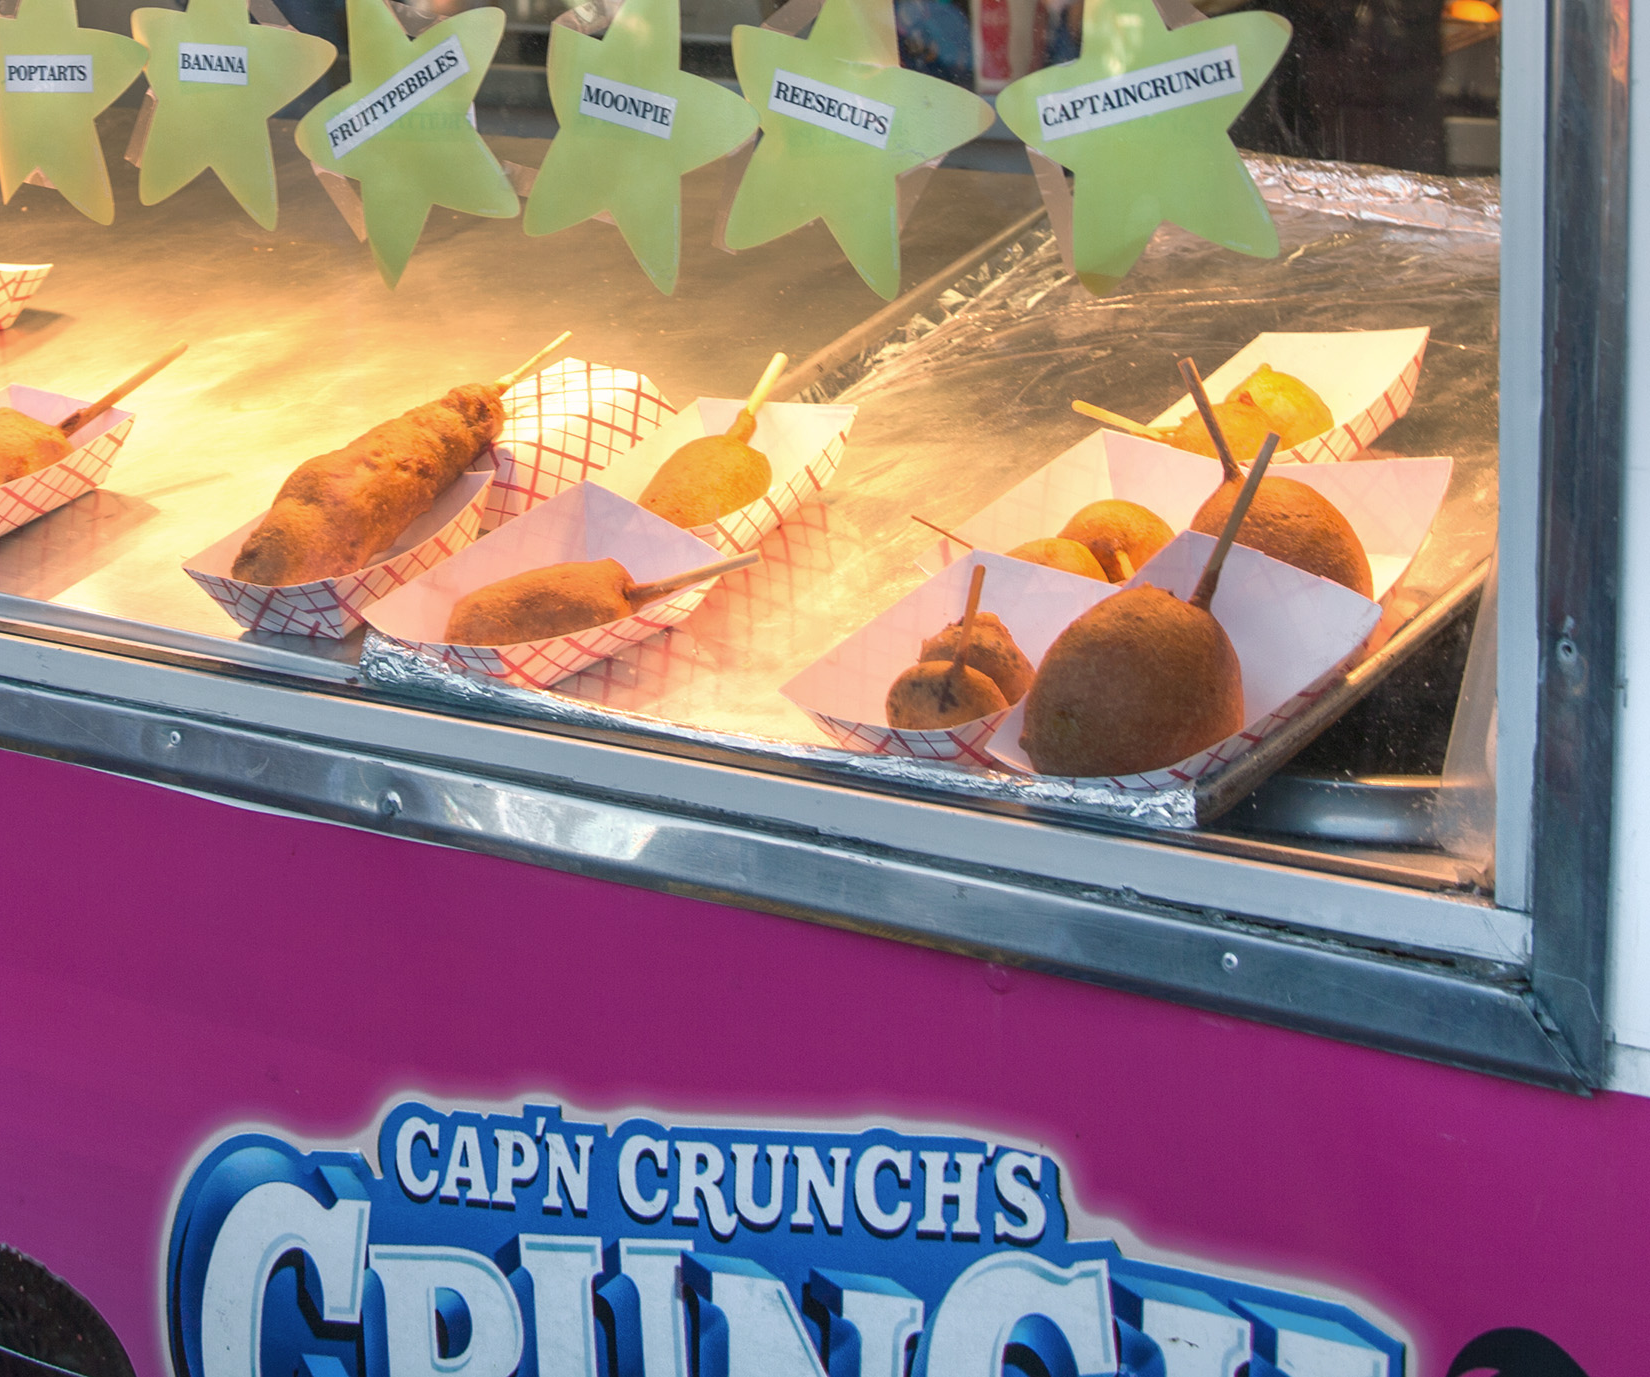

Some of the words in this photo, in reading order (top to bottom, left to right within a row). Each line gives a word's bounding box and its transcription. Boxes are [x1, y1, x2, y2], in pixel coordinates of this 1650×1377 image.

[6, 64, 88, 83] POPTARTS
[179, 53, 247, 74] BANANA
[327, 49, 460, 149] FRUITYPEBBLES
[581, 84, 673, 127] MOONPIE
[773, 80, 890, 136] REESECUPS
[1041, 58, 1238, 127] CAPTAINCRUNCH
[395, 1116, 595, 1215] CAP'N
[616, 1133, 1049, 1241] CRUNCH'S
